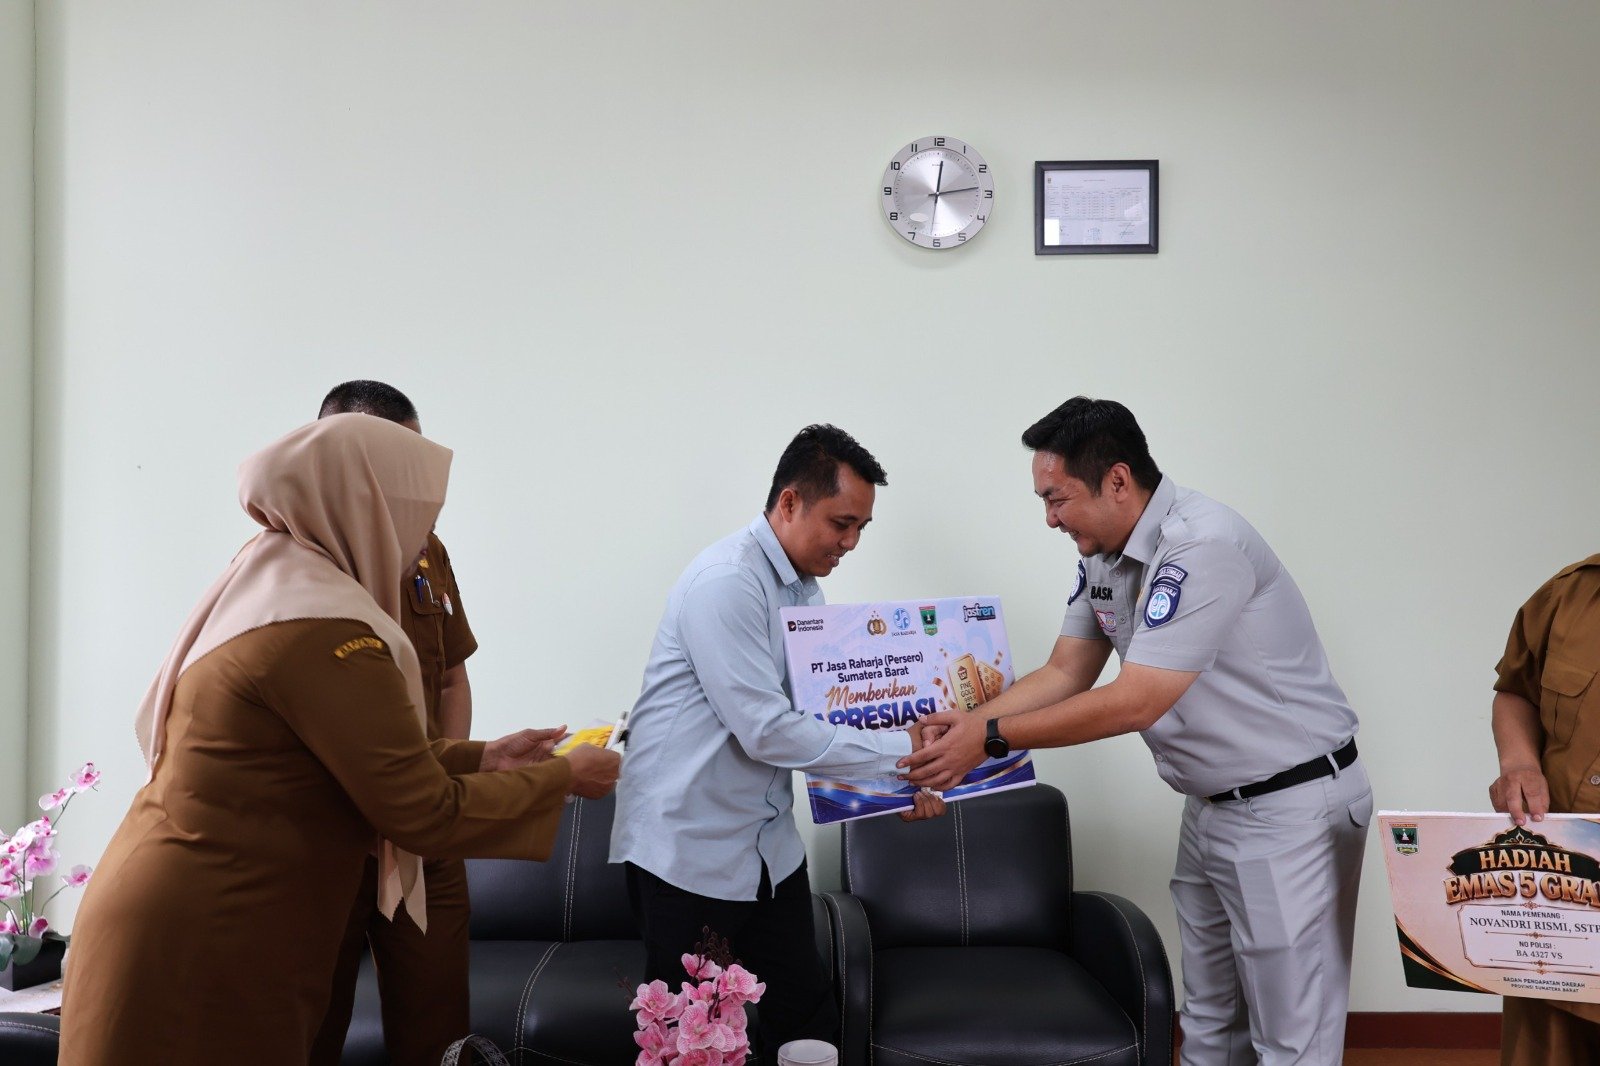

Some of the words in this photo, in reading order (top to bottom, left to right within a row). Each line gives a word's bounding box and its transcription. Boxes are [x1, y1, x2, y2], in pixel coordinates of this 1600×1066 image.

[934, 137, 945, 147] 12
[911, 143, 918, 153] 11
[963, 145, 966, 154] 1
[890, 161, 901, 171] 10
[978, 164, 987, 174] 2
[883, 186, 892, 196] 9
[984, 190, 993, 199] 3
[889, 212, 898, 221] 8
[976, 215, 986, 224] 4
[907, 231, 916, 241] 7
[958, 232, 967, 242] 5
[932, 238, 941, 248] 6
[796, 618, 824, 626] Danantara
[797, 625, 824, 633] Indonesia
[811, 662, 824, 673] PT
[826, 661, 847, 672] Jasa
[849, 656, 883, 669] Raharja
[885, 651, 924, 667] (Persero)
[837, 668, 883, 683] Sumatera
[884, 666, 910, 677] Barat
[960, 681, 972, 690] FINE
[825, 679, 917, 715] Memberikan
[961, 687, 976, 698] GOLD
[814, 697, 937, 731] PRESIASI
[1478, 848, 1572, 873] HADIAH
[1443, 871, 1517, 905] EMAS
[1519, 871, 1537, 899] 5
[1540, 873, 1600, 908] GRA
[1501, 909, 1521, 917] NAMA
[1522, 911, 1561, 919] PEMENANG
[1469, 917, 1531, 930] NOVANDRI
[1534, 920, 1572, 933] RISMI,
[1530, 941, 1552, 949] POLISI
[1516, 949, 1529, 957] BA
[1530, 950, 1549, 959] 4327
[1551, 952, 1563, 960] VS
[1503, 976, 1522, 984] BADAN
[1523, 978, 1561, 987] PENDAPATAN
